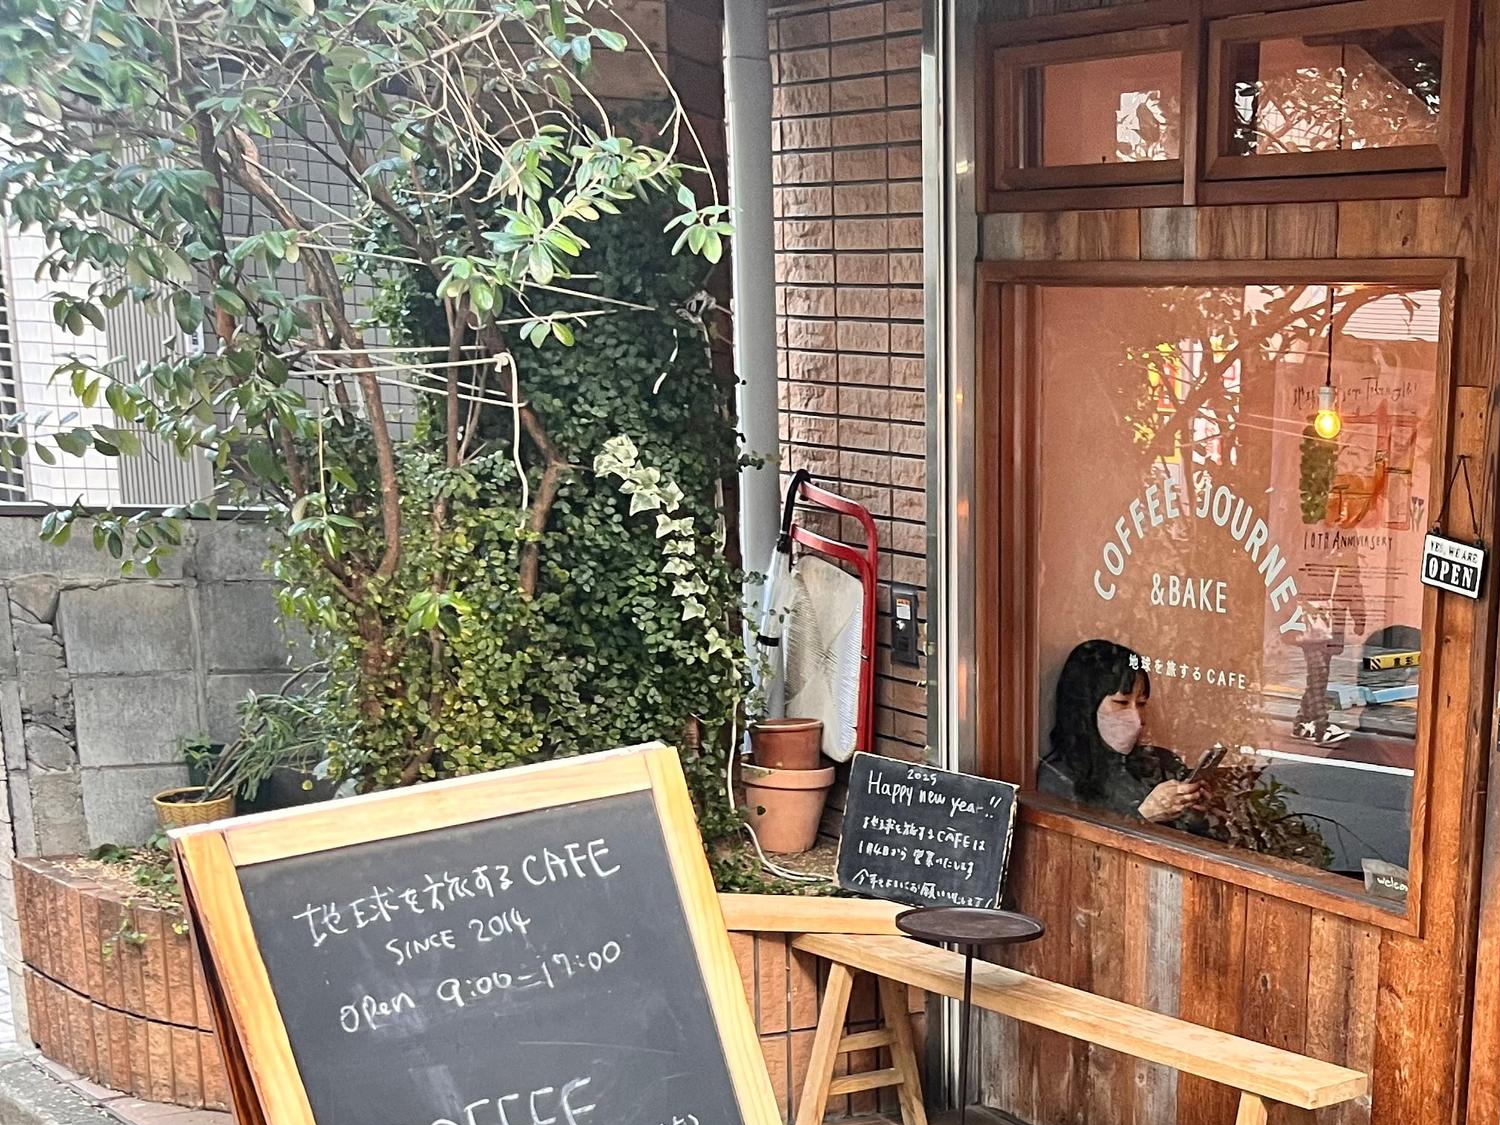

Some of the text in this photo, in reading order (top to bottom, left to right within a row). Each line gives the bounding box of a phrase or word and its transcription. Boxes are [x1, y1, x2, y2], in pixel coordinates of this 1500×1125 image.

[1094, 477, 1180, 601] COFFEE
[1196, 477, 1307, 634] JOURNEY
[1428, 557, 1473, 589] OPEN
[1461, 550, 1478, 564] ARE
[1128, 653, 1246, 690] 地球を旅する CAFE
[868, 770, 914, 807] Happy
[919, 789, 946, 805] new
[907, 769, 938, 785] 2025
[292, 838, 621, 947] 地球を旅する CAFE
[385, 907, 531, 965] SINCE 2014
